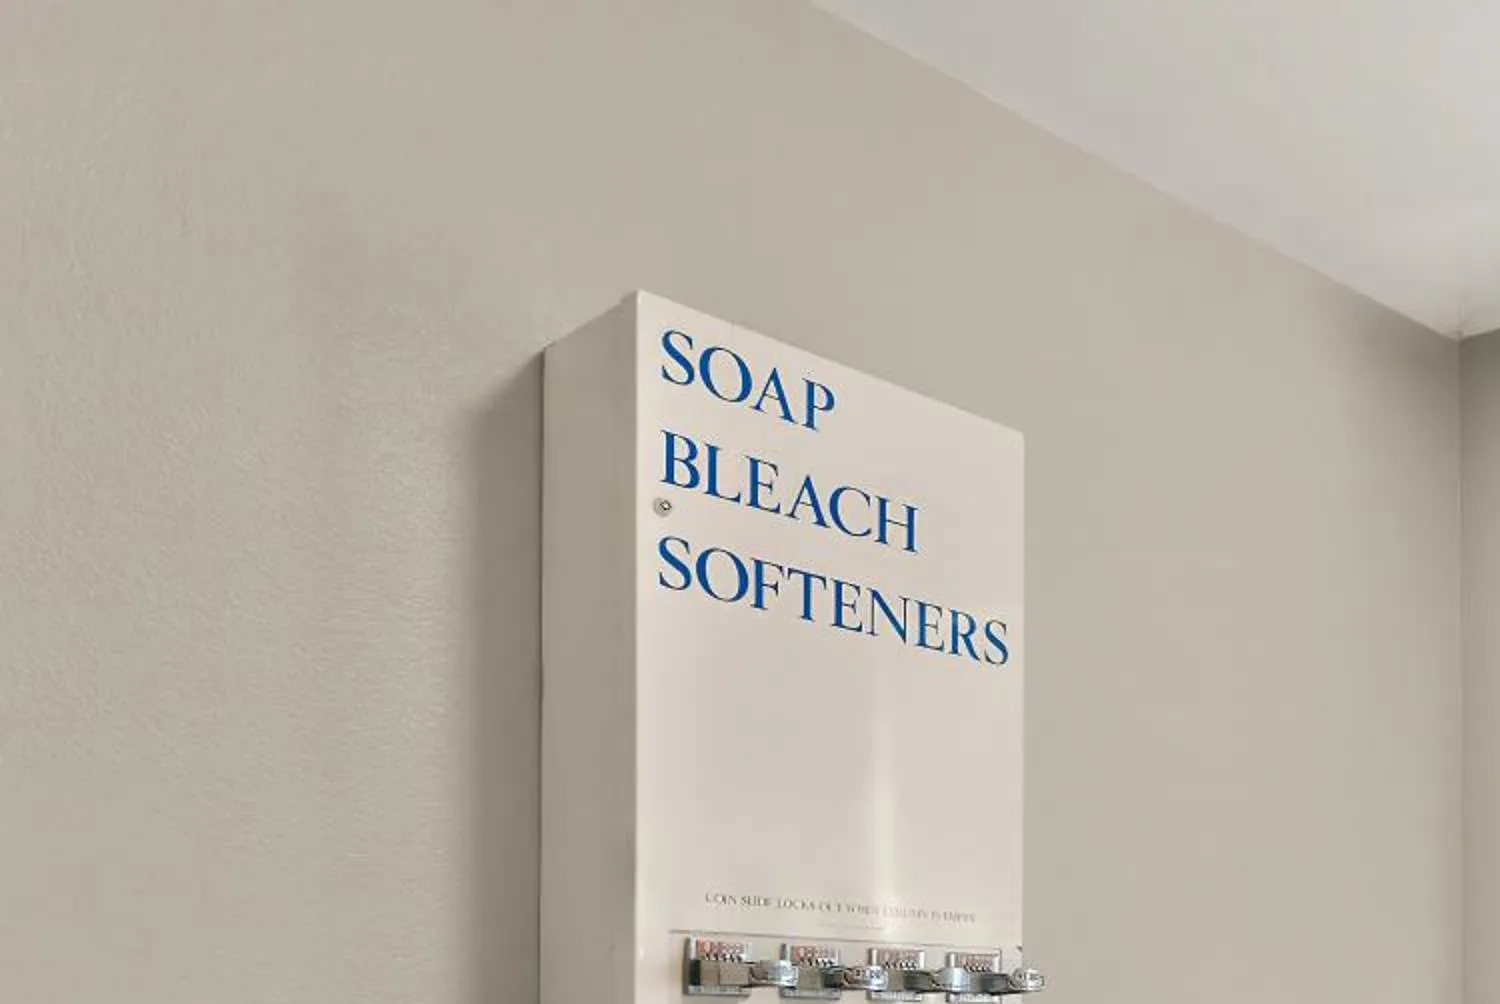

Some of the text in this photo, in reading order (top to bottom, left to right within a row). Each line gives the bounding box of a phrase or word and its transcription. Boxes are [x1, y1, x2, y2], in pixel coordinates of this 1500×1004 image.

[661, 329, 835, 431] SOAP
[660, 429, 919, 555] BLEACH
[658, 535, 1009, 666] SOFTENERS
